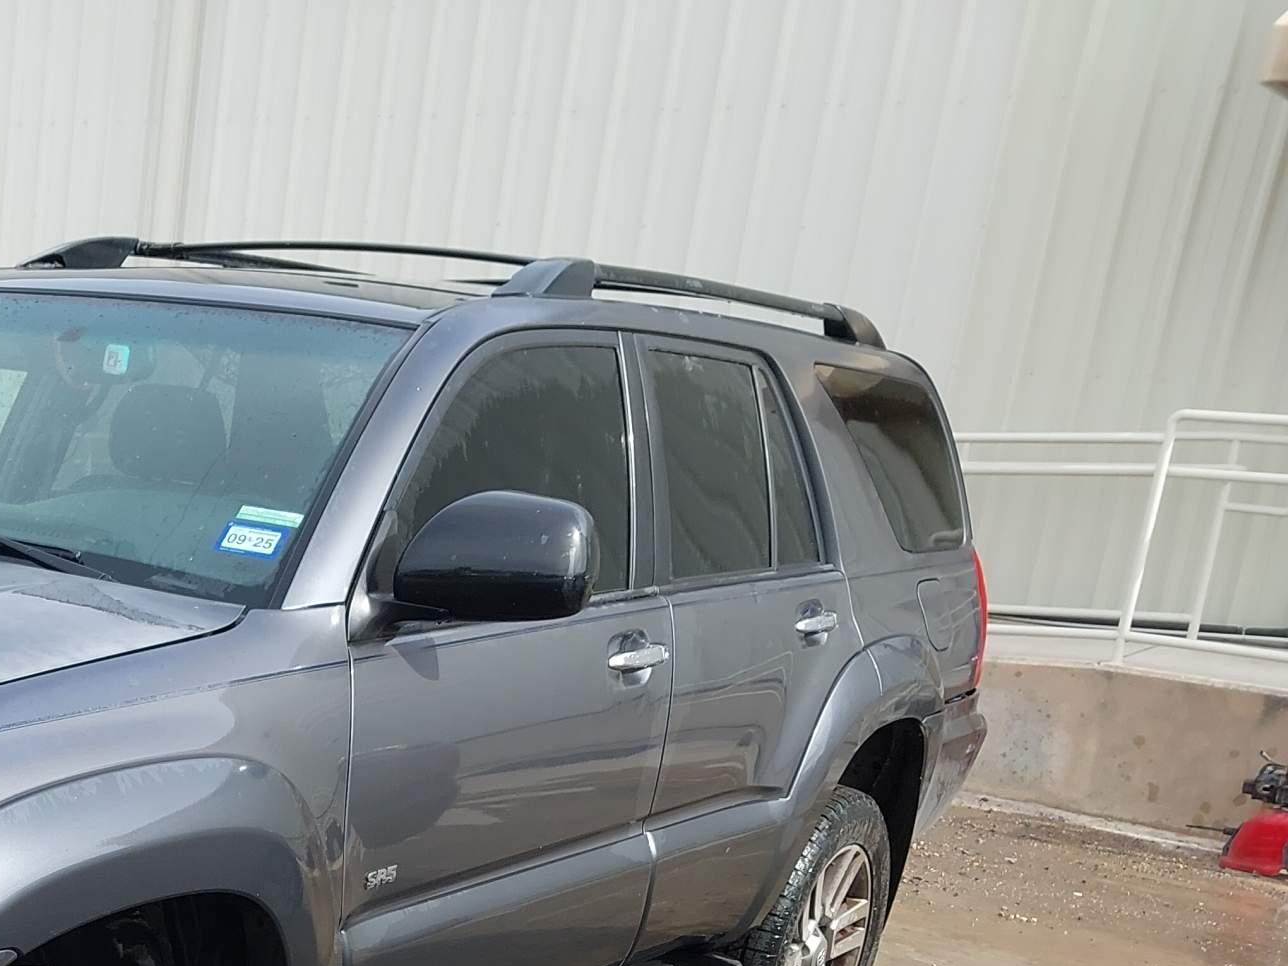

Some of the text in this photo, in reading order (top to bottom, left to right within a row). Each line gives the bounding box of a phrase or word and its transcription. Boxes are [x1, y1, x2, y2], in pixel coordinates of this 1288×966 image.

[226, 533, 275, 549] 09 25
[366, 864, 398, 889] SR5
